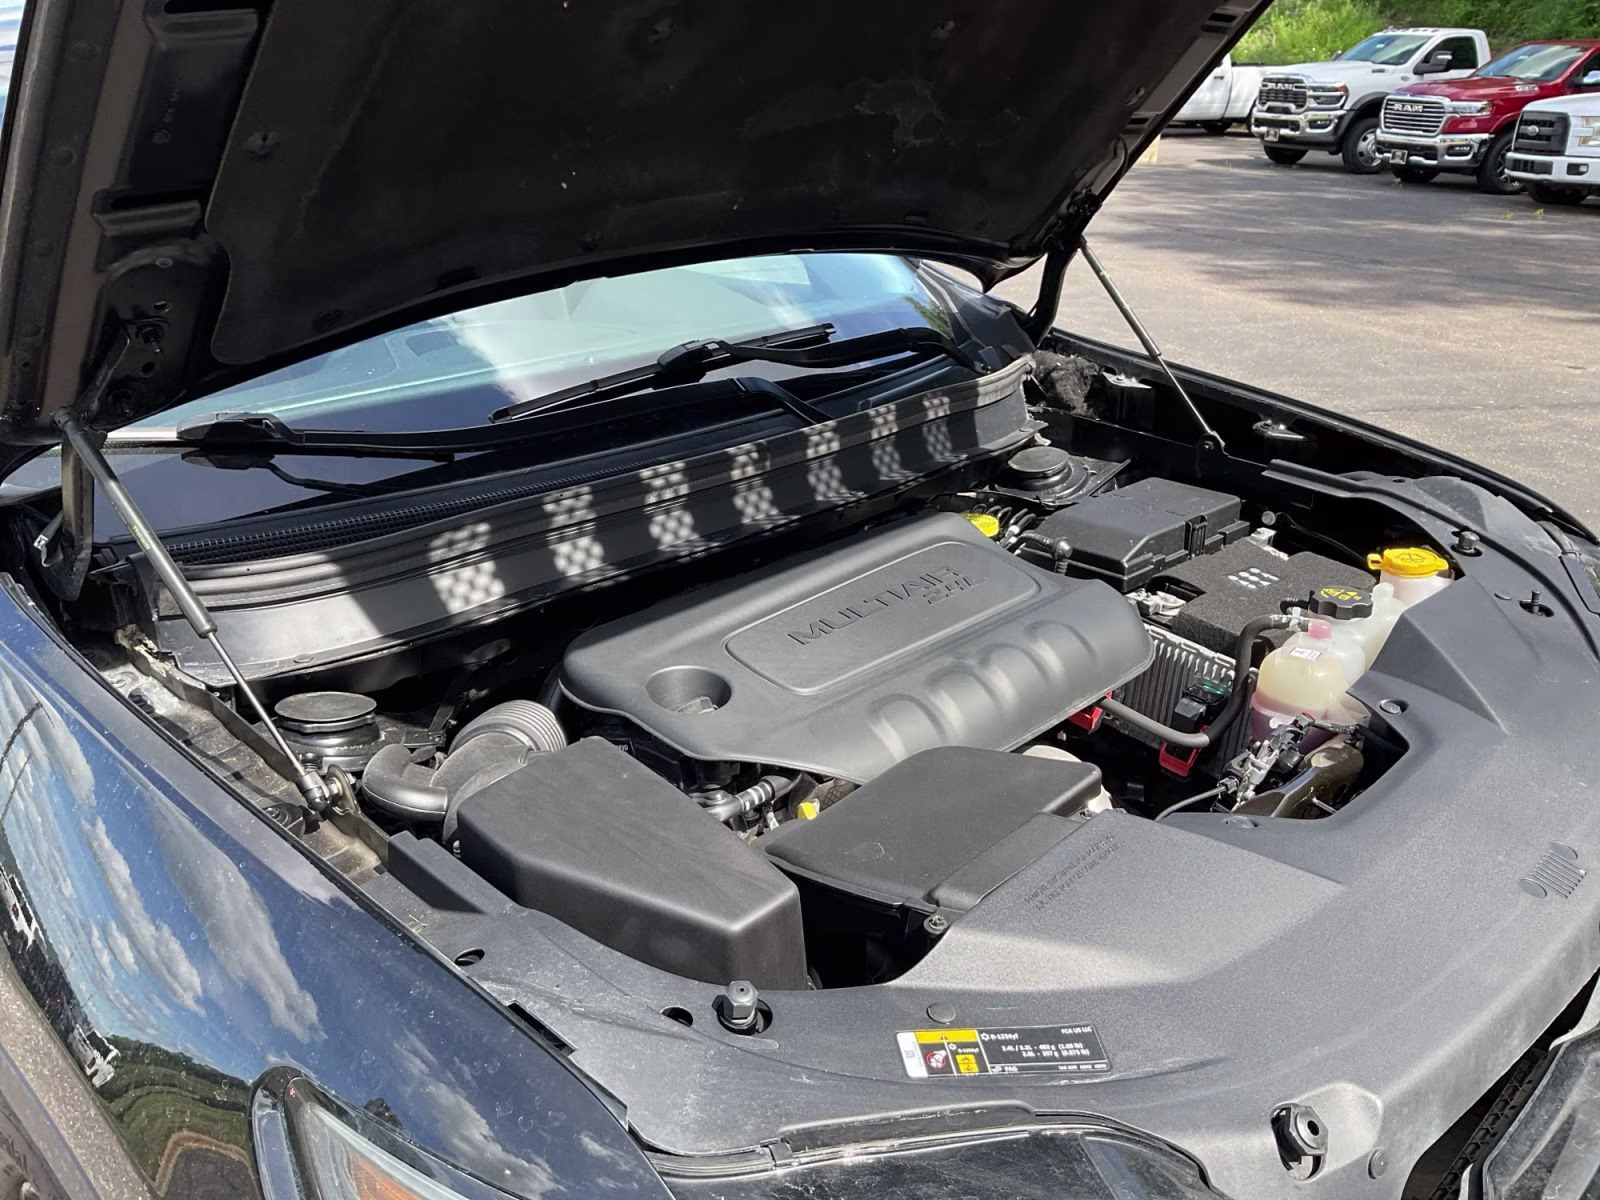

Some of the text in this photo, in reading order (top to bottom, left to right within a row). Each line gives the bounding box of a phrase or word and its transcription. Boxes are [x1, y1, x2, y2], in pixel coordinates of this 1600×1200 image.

[1269, 83, 1294, 91] RAM
[1393, 103, 1424, 113] RAM
[787, 567, 959, 646] MULTIAIR
